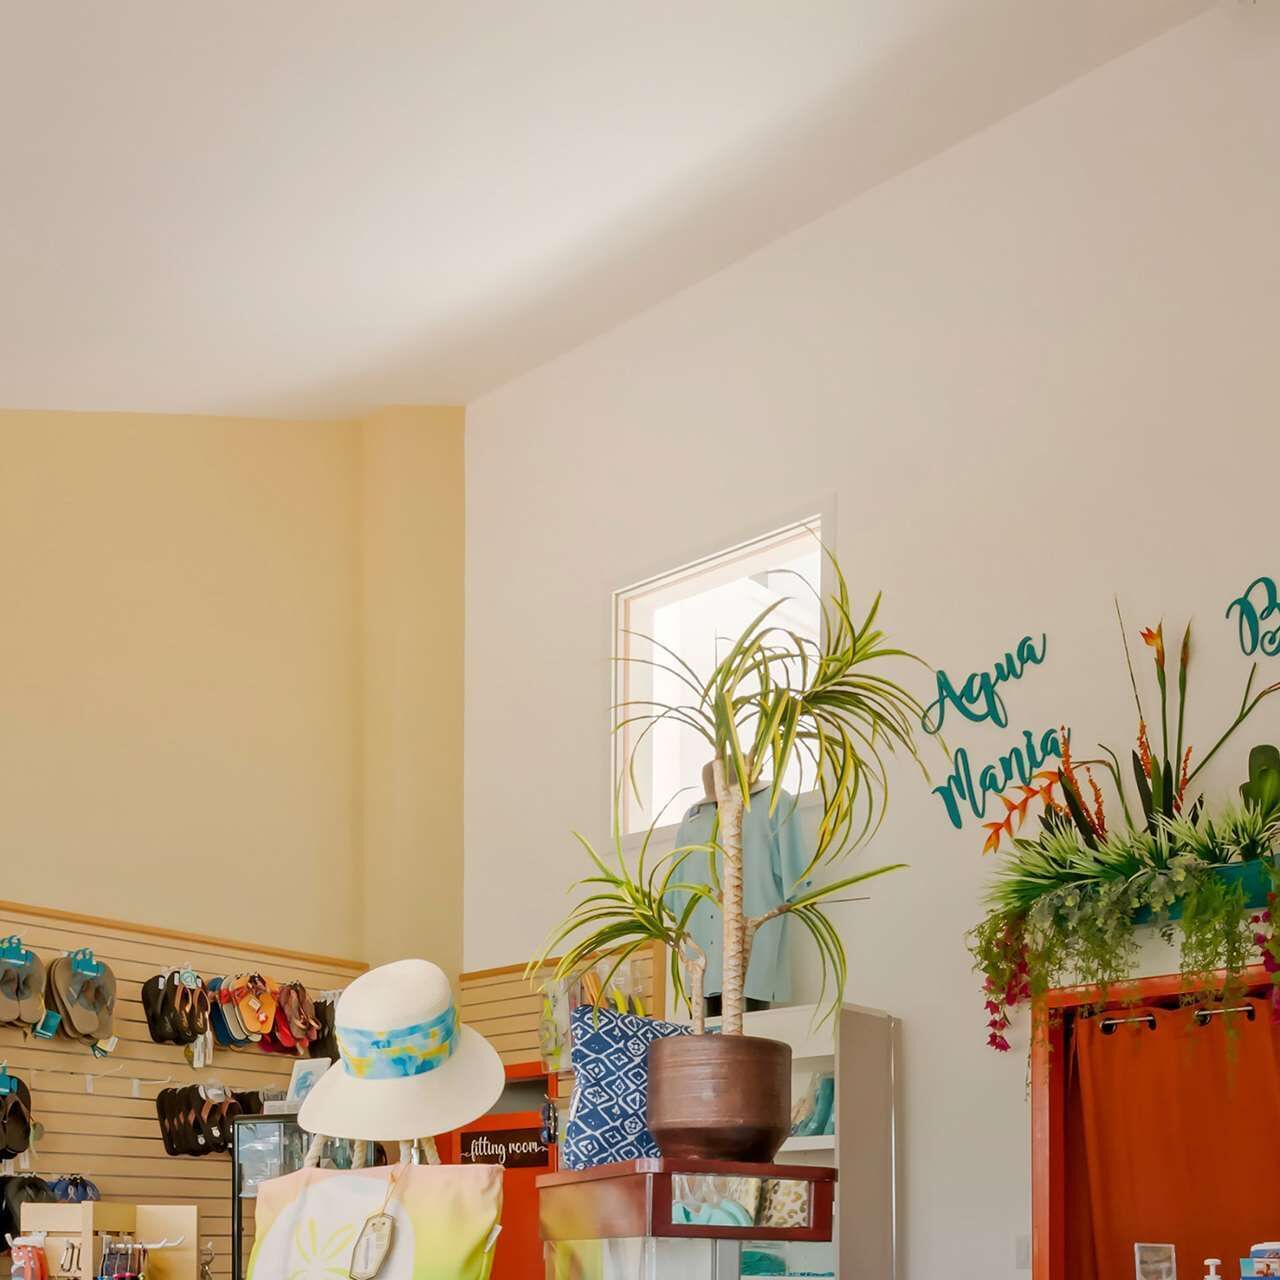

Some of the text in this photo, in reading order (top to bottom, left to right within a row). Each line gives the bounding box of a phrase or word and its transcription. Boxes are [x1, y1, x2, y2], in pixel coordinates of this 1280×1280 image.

[922, 632, 1047, 736] Aqua
[932, 727, 1071, 829] Mania
[465, 1136, 547, 1164] fitting room
